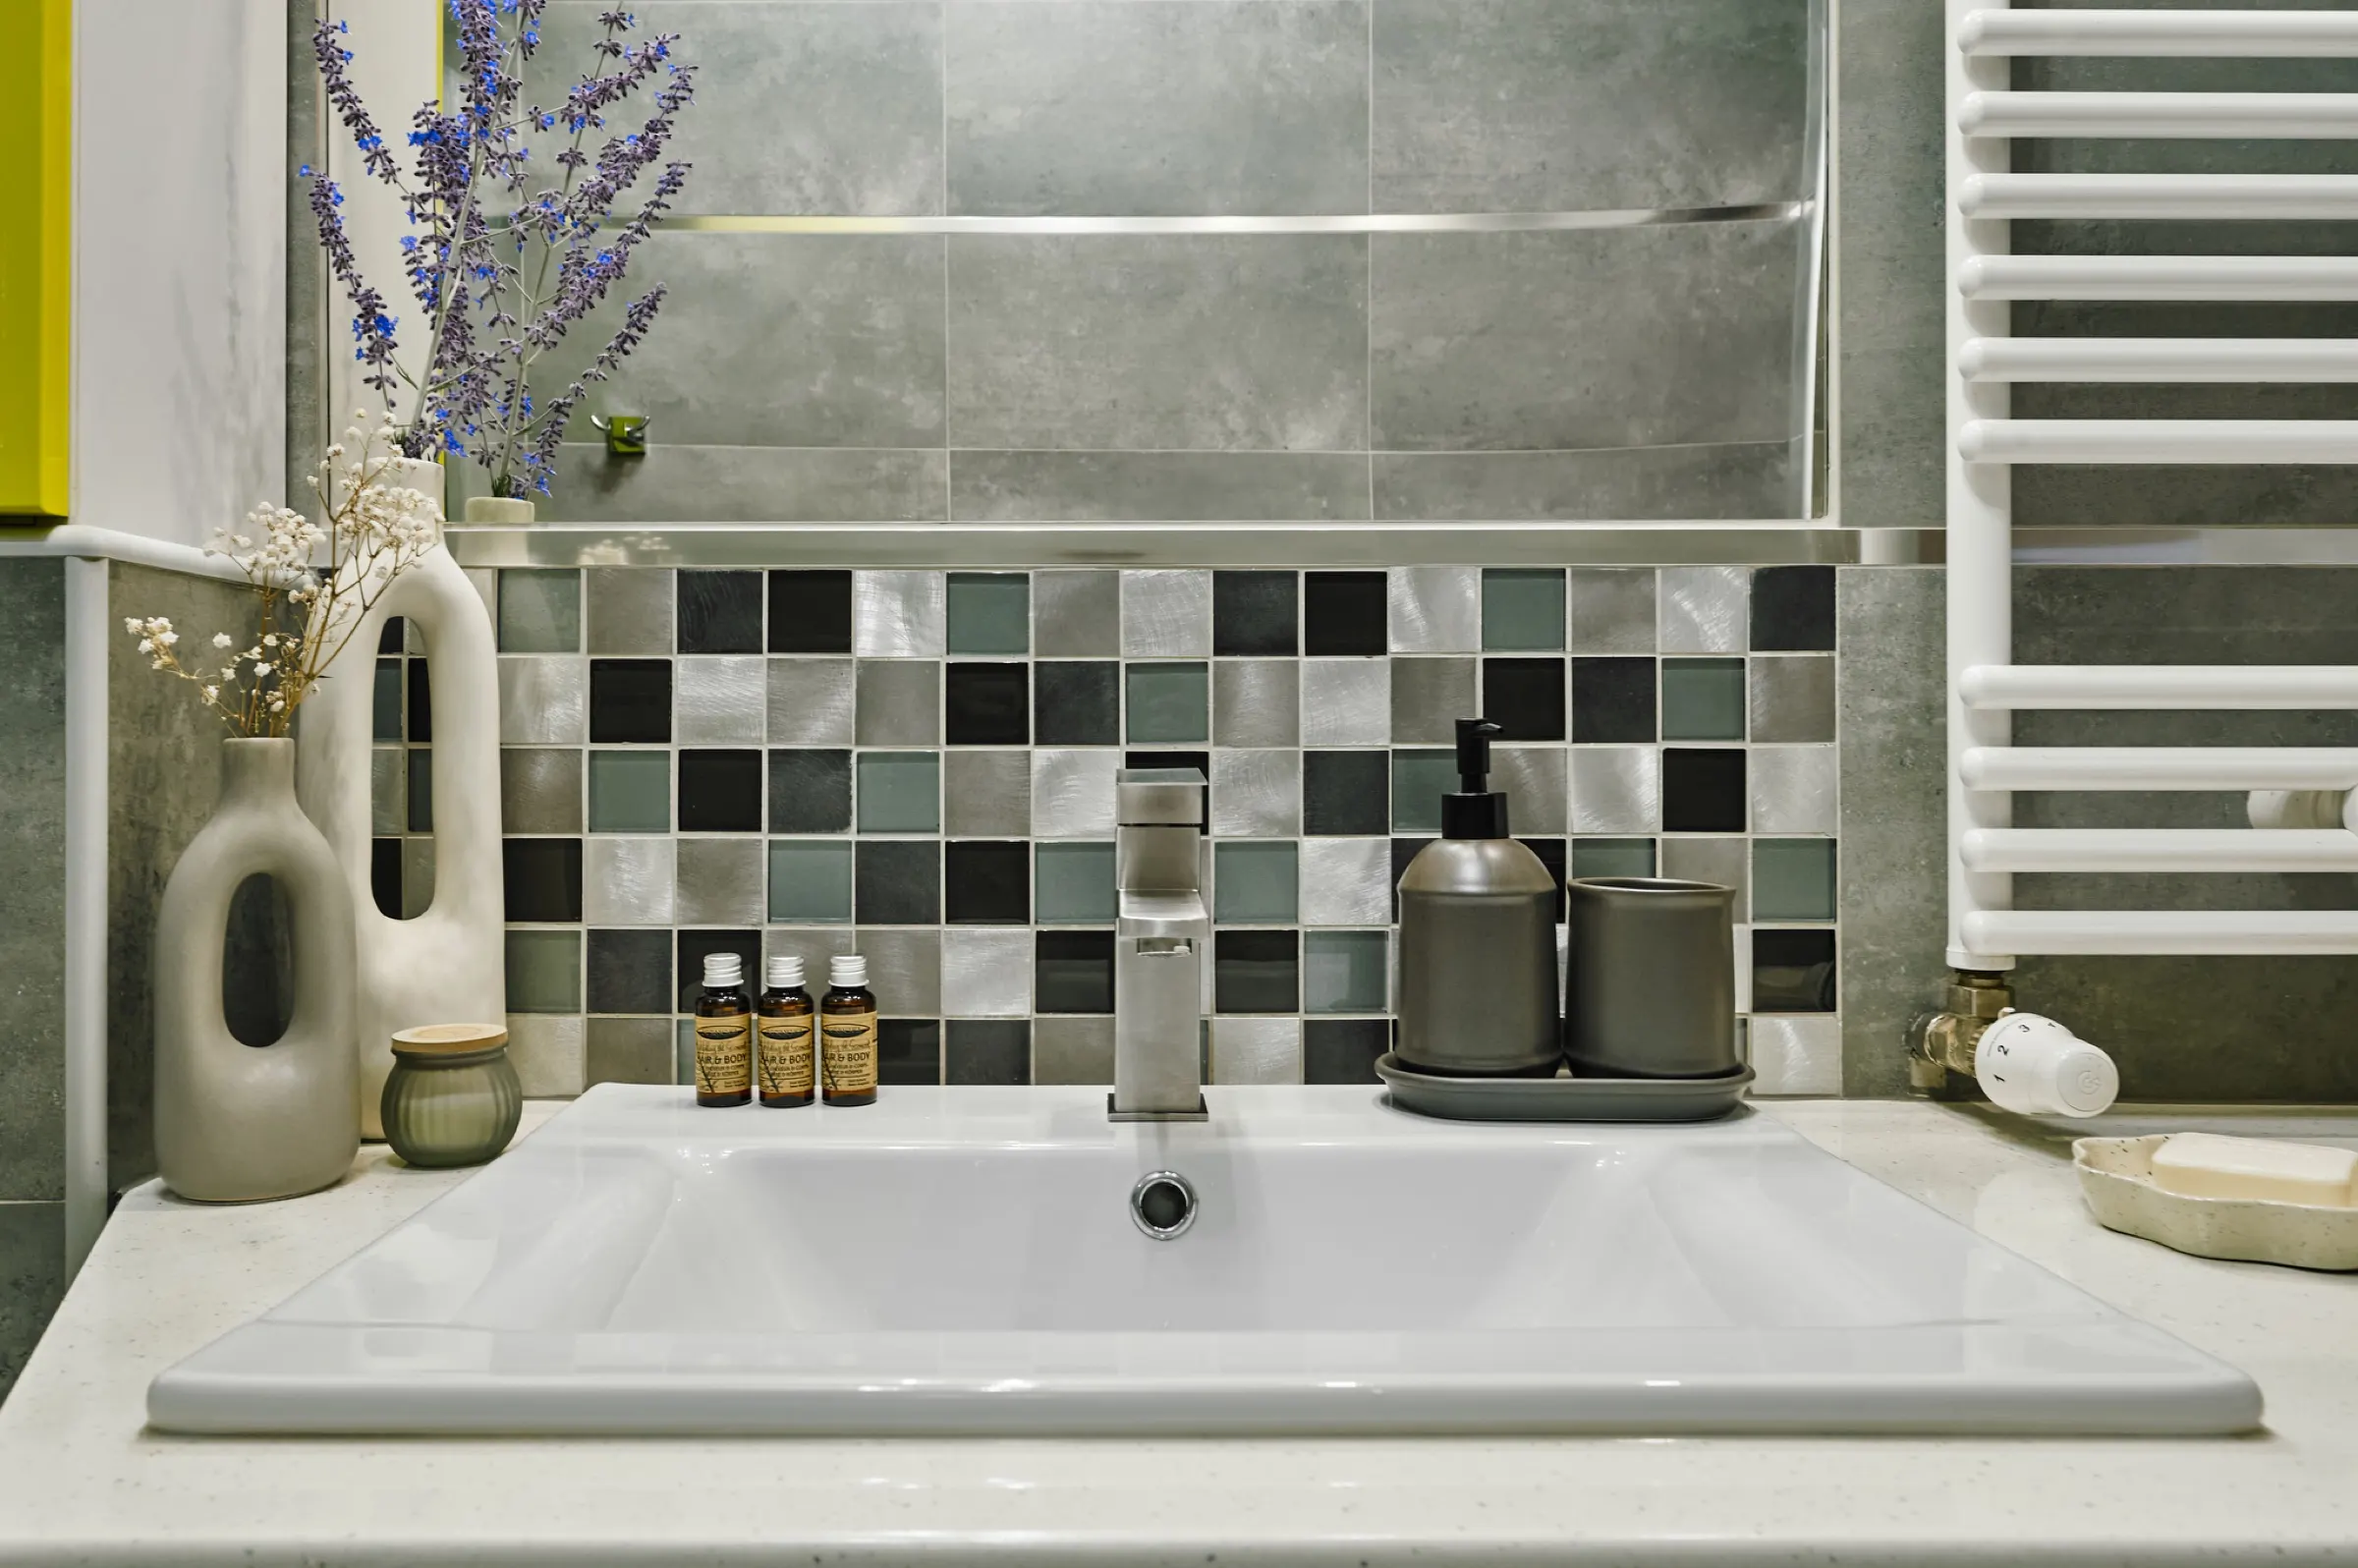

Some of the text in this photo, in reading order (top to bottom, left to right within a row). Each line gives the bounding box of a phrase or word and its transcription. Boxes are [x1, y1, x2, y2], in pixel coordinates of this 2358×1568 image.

[2018, 1024, 2031, 1033] 3
[1997, 1044, 2009, 1056] 2
[715, 1055, 722, 1065] &
[724, 1053, 747, 1065] BODY
[779, 1055, 786, 1065] &
[789, 1053, 811, 1065] BODY
[838, 1053, 845, 1062] &
[847, 1051, 870, 1062] BODY
[1993, 1074, 2006, 1083] 1
